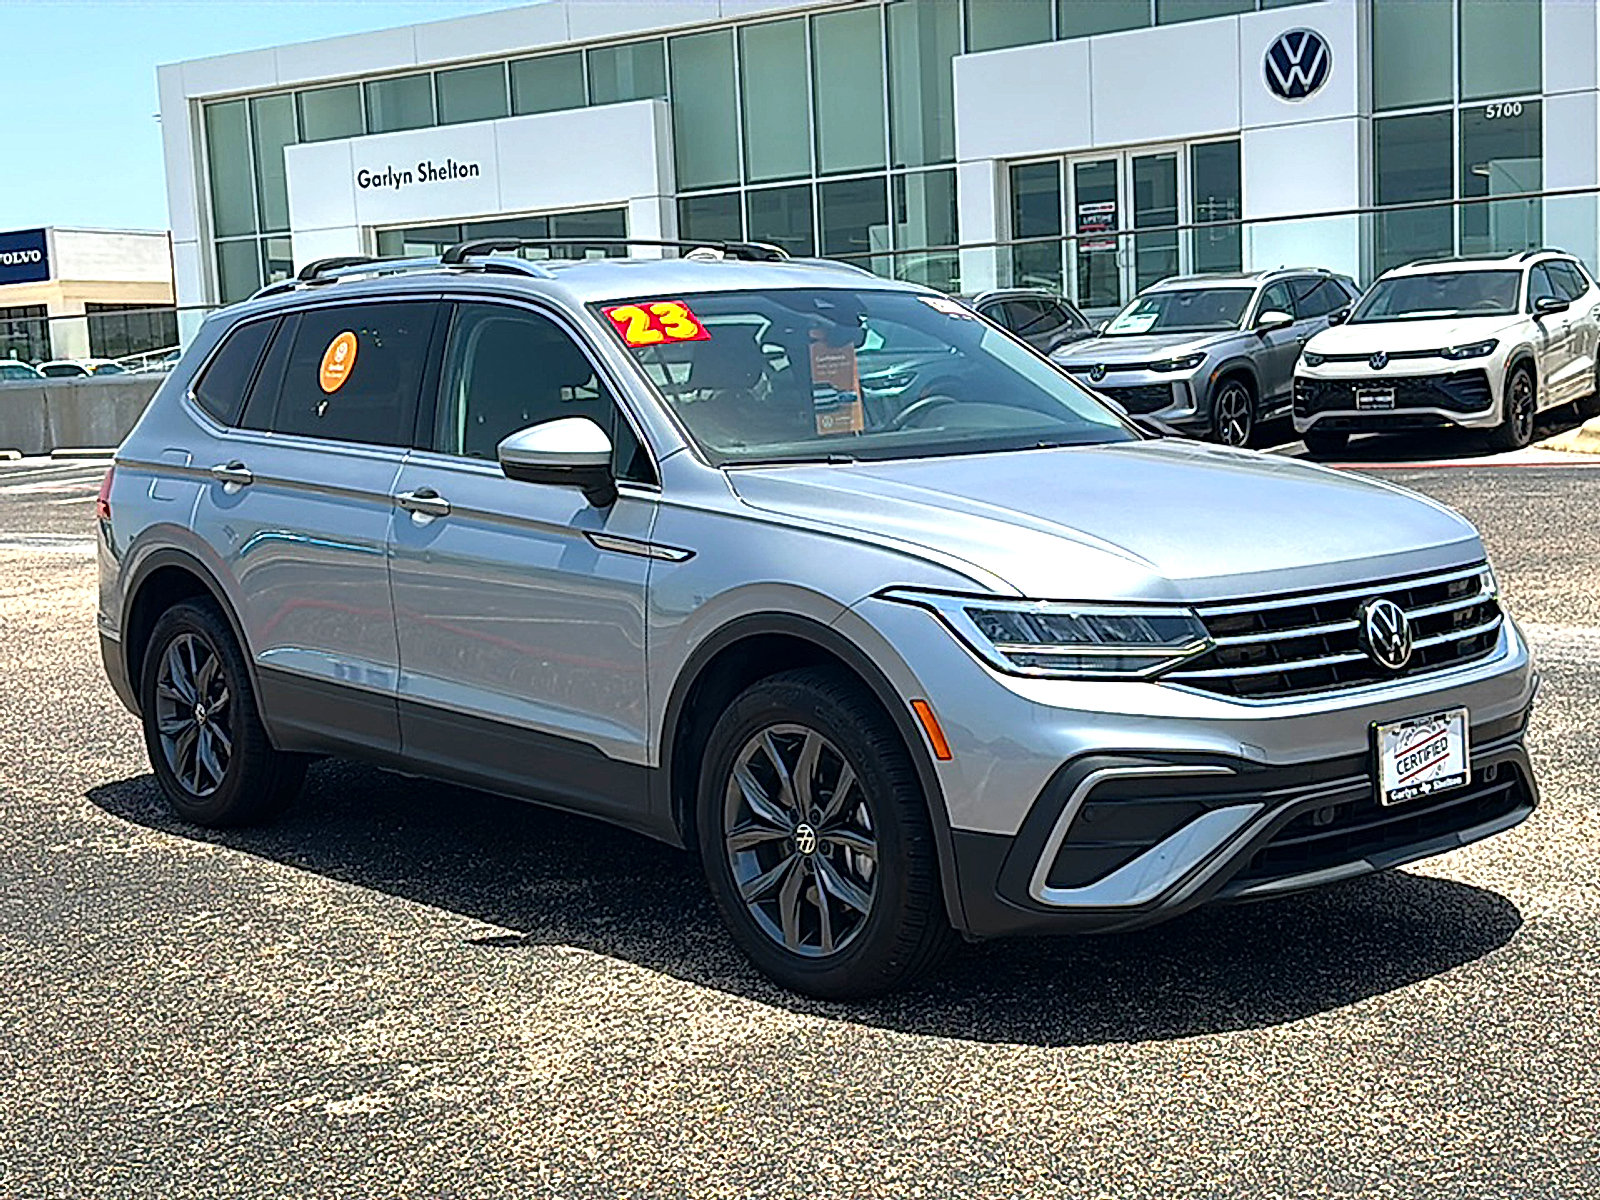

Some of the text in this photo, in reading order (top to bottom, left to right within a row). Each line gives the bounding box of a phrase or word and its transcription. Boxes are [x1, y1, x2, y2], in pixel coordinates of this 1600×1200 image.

[1485, 102, 1523, 119] 5700
[357, 158, 480, 190] Garlyn Shelton
[609, 302, 699, 345] 23
[1395, 736, 1449, 776] CERTIFIED
